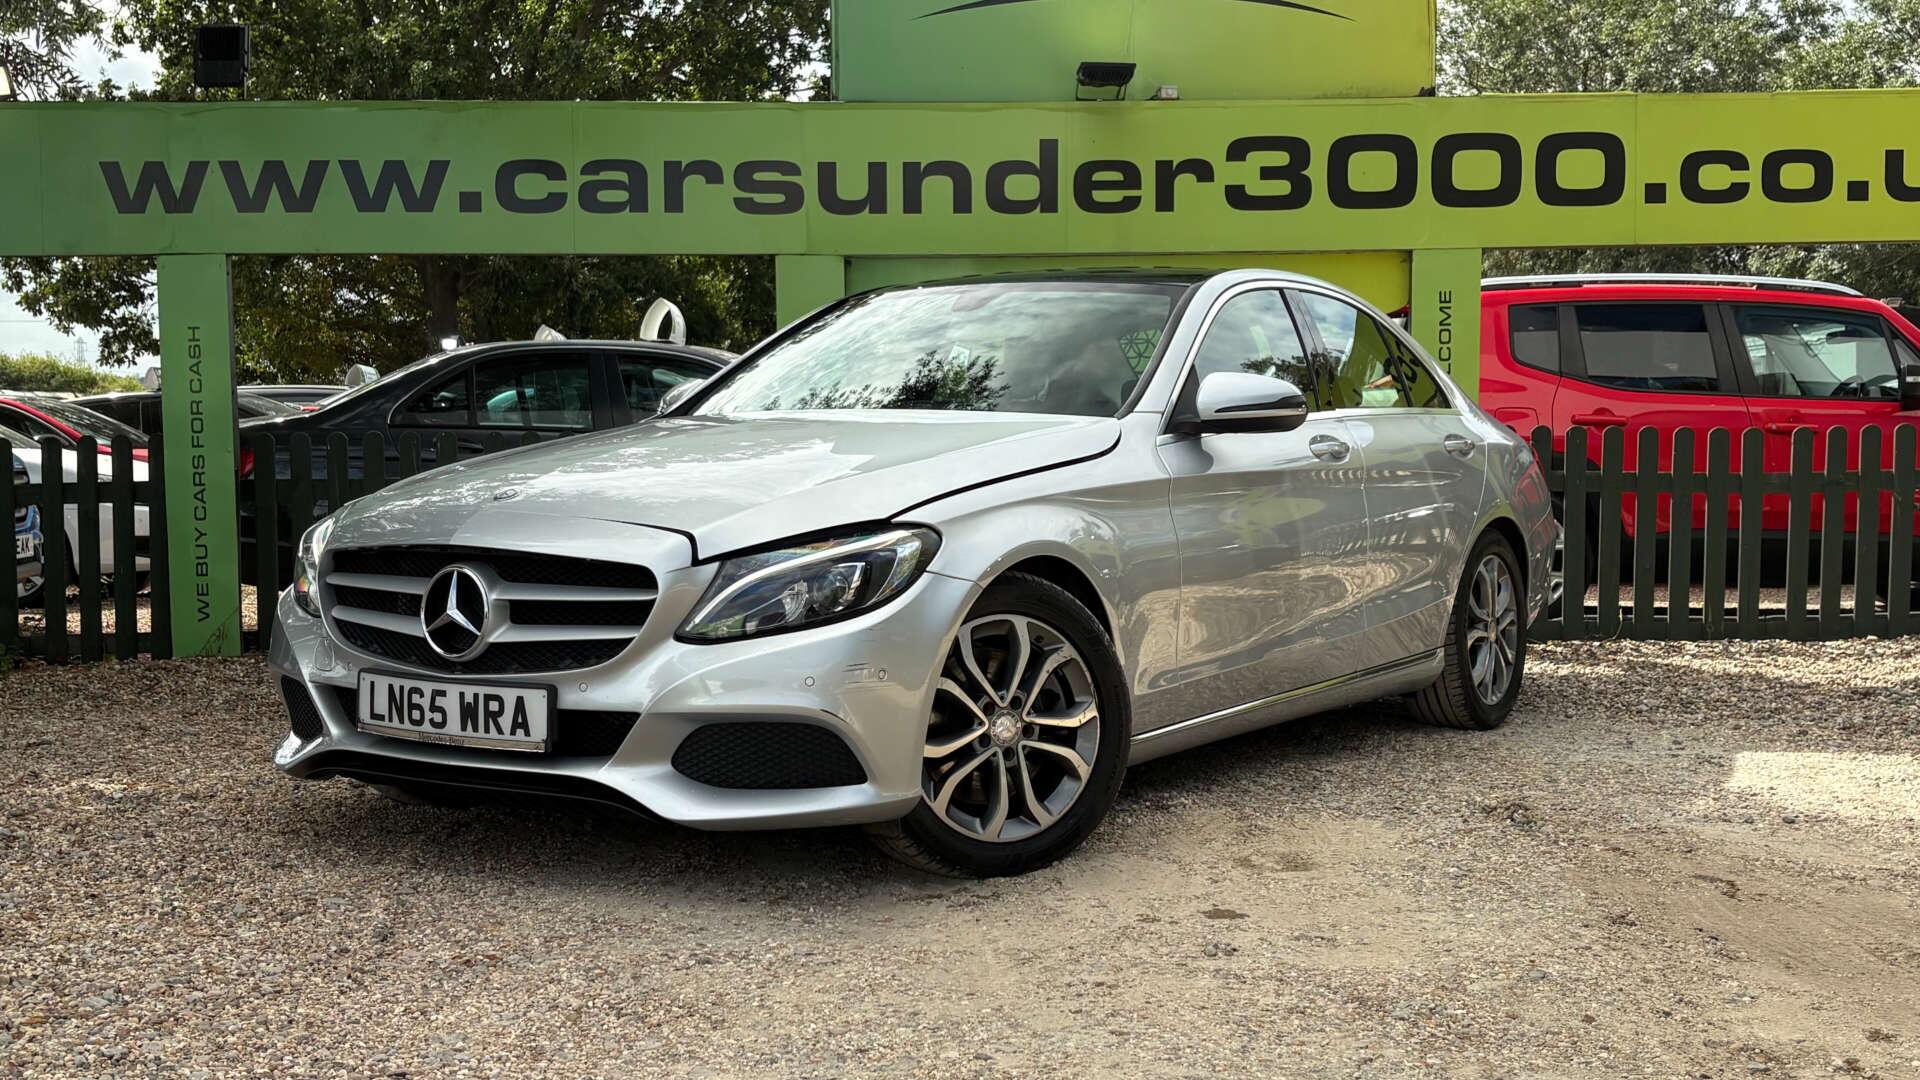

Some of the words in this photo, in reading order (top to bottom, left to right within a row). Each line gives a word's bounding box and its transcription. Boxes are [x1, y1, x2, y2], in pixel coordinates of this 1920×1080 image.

[188, 326, 202, 394] CASH
[191, 400, 204, 448] FOR
[192, 455, 206, 521] CARS
[195, 528, 208, 577] BUY
[197, 583, 210, 622] WE
[370, 681, 448, 729] LN65
[459, 692, 531, 737] WRA
